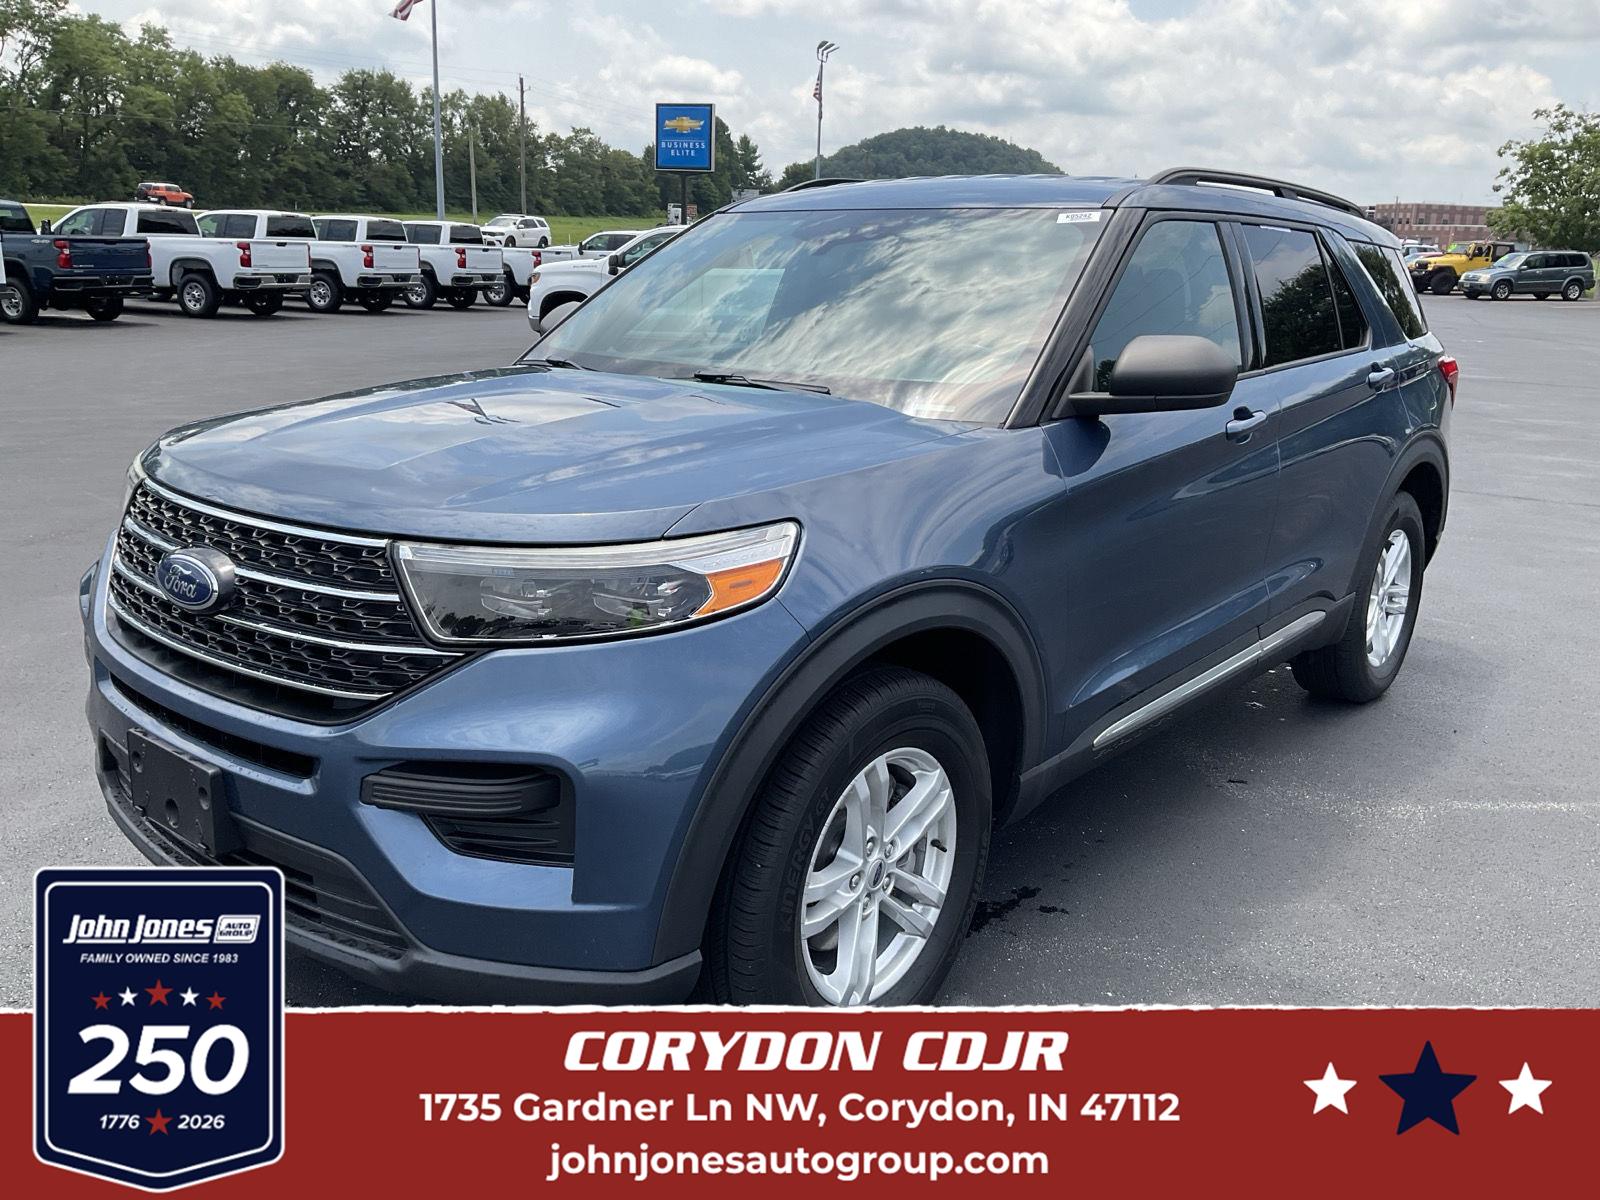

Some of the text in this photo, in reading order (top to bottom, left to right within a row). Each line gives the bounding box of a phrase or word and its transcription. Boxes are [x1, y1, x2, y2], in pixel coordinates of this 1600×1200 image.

[661, 141, 706, 149] BUSINESS
[670, 149, 696, 157] ELITE
[164, 564, 198, 598] Ford
